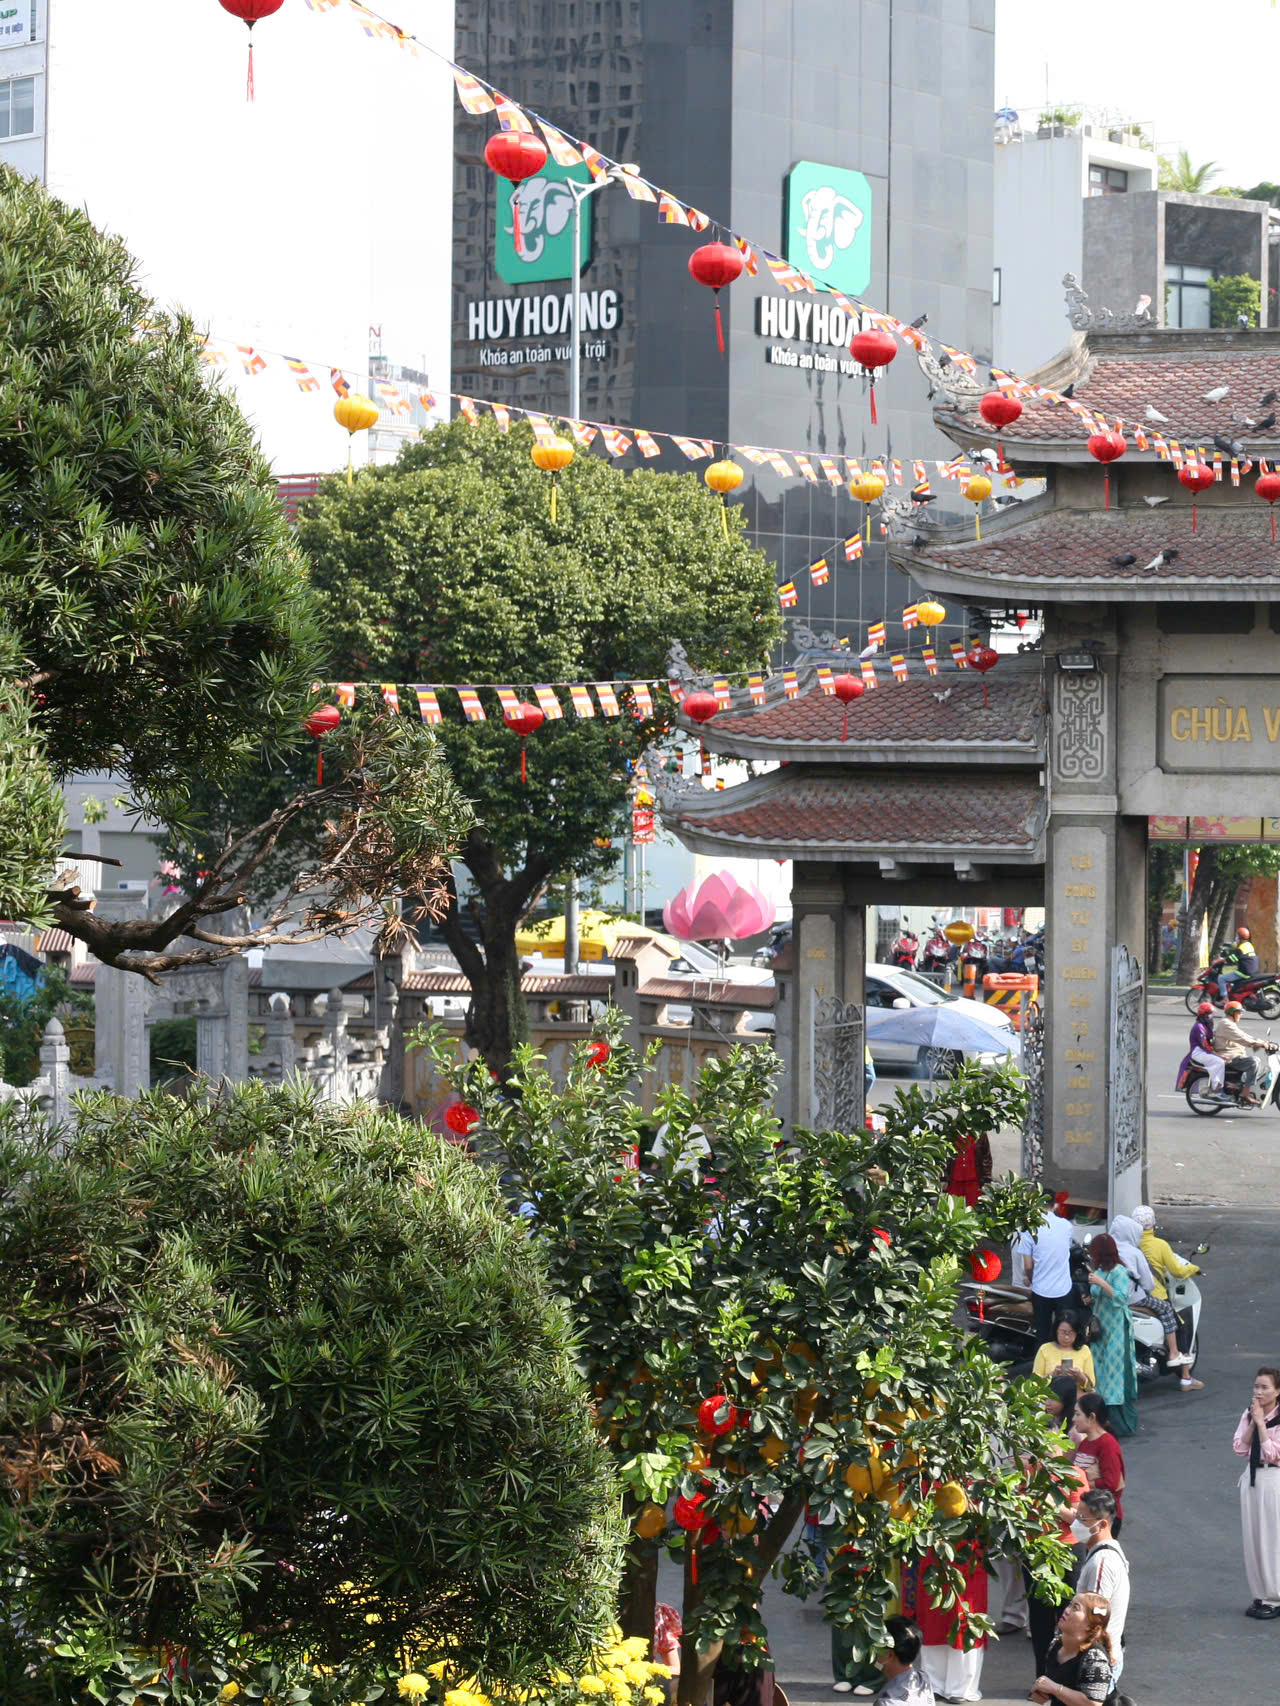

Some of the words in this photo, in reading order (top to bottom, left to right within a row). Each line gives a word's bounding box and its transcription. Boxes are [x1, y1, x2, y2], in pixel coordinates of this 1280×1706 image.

[468, 289, 618, 341] HUYHOANG
[480, 347, 508, 366] Khóa
[510, 351, 523, 364] an
[526, 346, 551, 362] toàn
[585, 340, 606, 362] trội
[771, 345, 798, 367] Khóa
[799, 353, 813, 368] an
[814, 352, 838, 373] toàn
[1171, 696, 1252, 743] CHÙA
